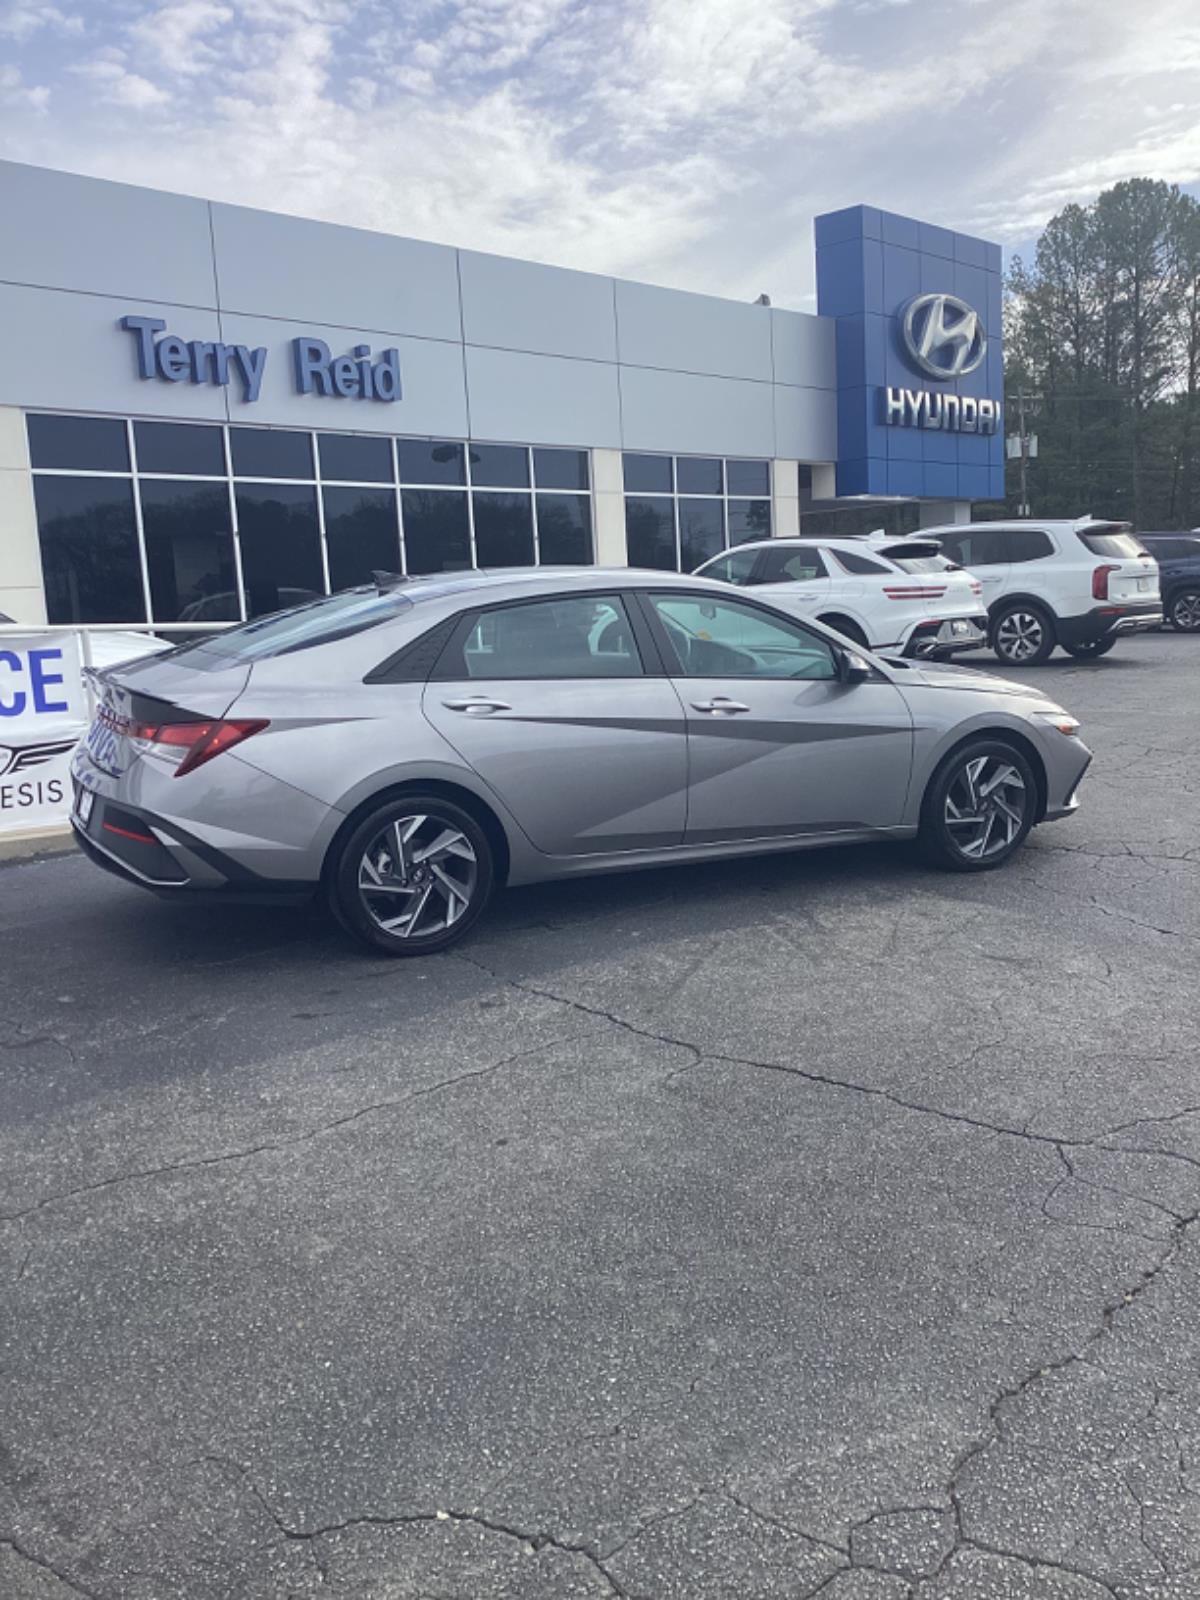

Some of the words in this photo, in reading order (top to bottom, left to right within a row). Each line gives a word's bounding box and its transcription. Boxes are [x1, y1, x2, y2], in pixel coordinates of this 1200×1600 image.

[121, 315, 267, 402] Terry
[292, 337, 402, 401] Reid
[884, 387, 1001, 434] HYUNDAI
